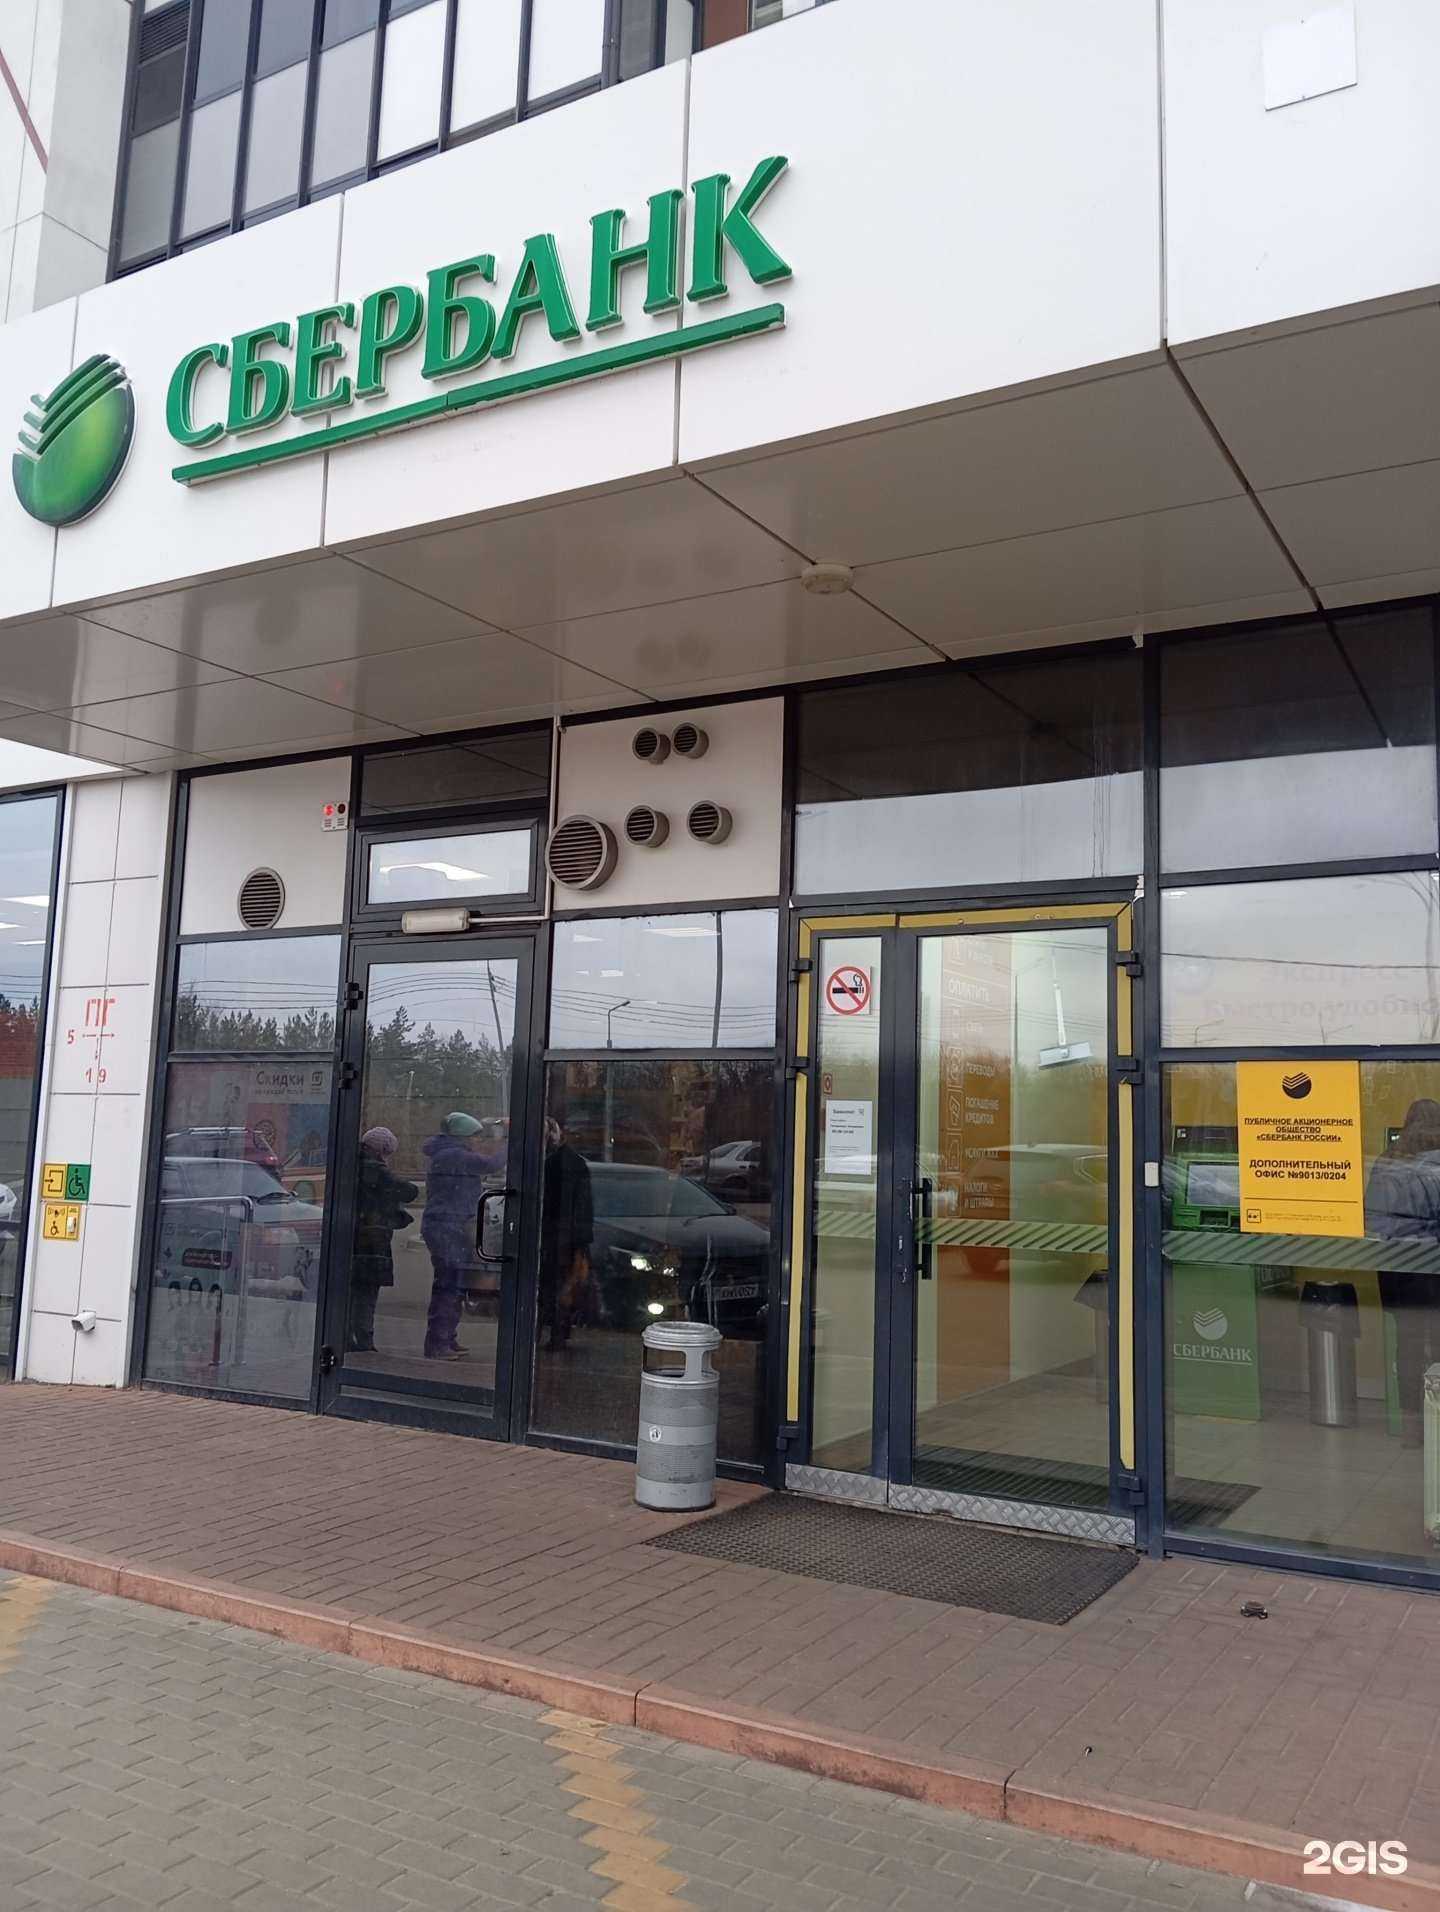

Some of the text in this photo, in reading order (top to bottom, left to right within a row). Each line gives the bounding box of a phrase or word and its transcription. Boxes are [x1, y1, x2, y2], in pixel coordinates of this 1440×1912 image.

[166, 155, 793, 449] СБЕРБАНК
[85, 998, 116, 1027] ПГ
[67, 1028, 75, 1045] 5
[255, 1070, 305, 1088] Скидки
[1244, 1117, 1353, 1127] ПУБЛИЧНОЕ АКЦИОНЕРНОЕ
[1275, 1126, 1321, 1134] ОБЩЕСТВО
[1256, 1133, 1342, 1142] «СБЕРБАНК РОССИИ»
[1249, 1159, 1352, 1170] ДОПОЛНИТЕЛЬНЫЙ
[1255, 1169, 1347, 1181] ОФИС №9013/0204
[1173, 1343, 1253, 1361] СБЕРБАНК
